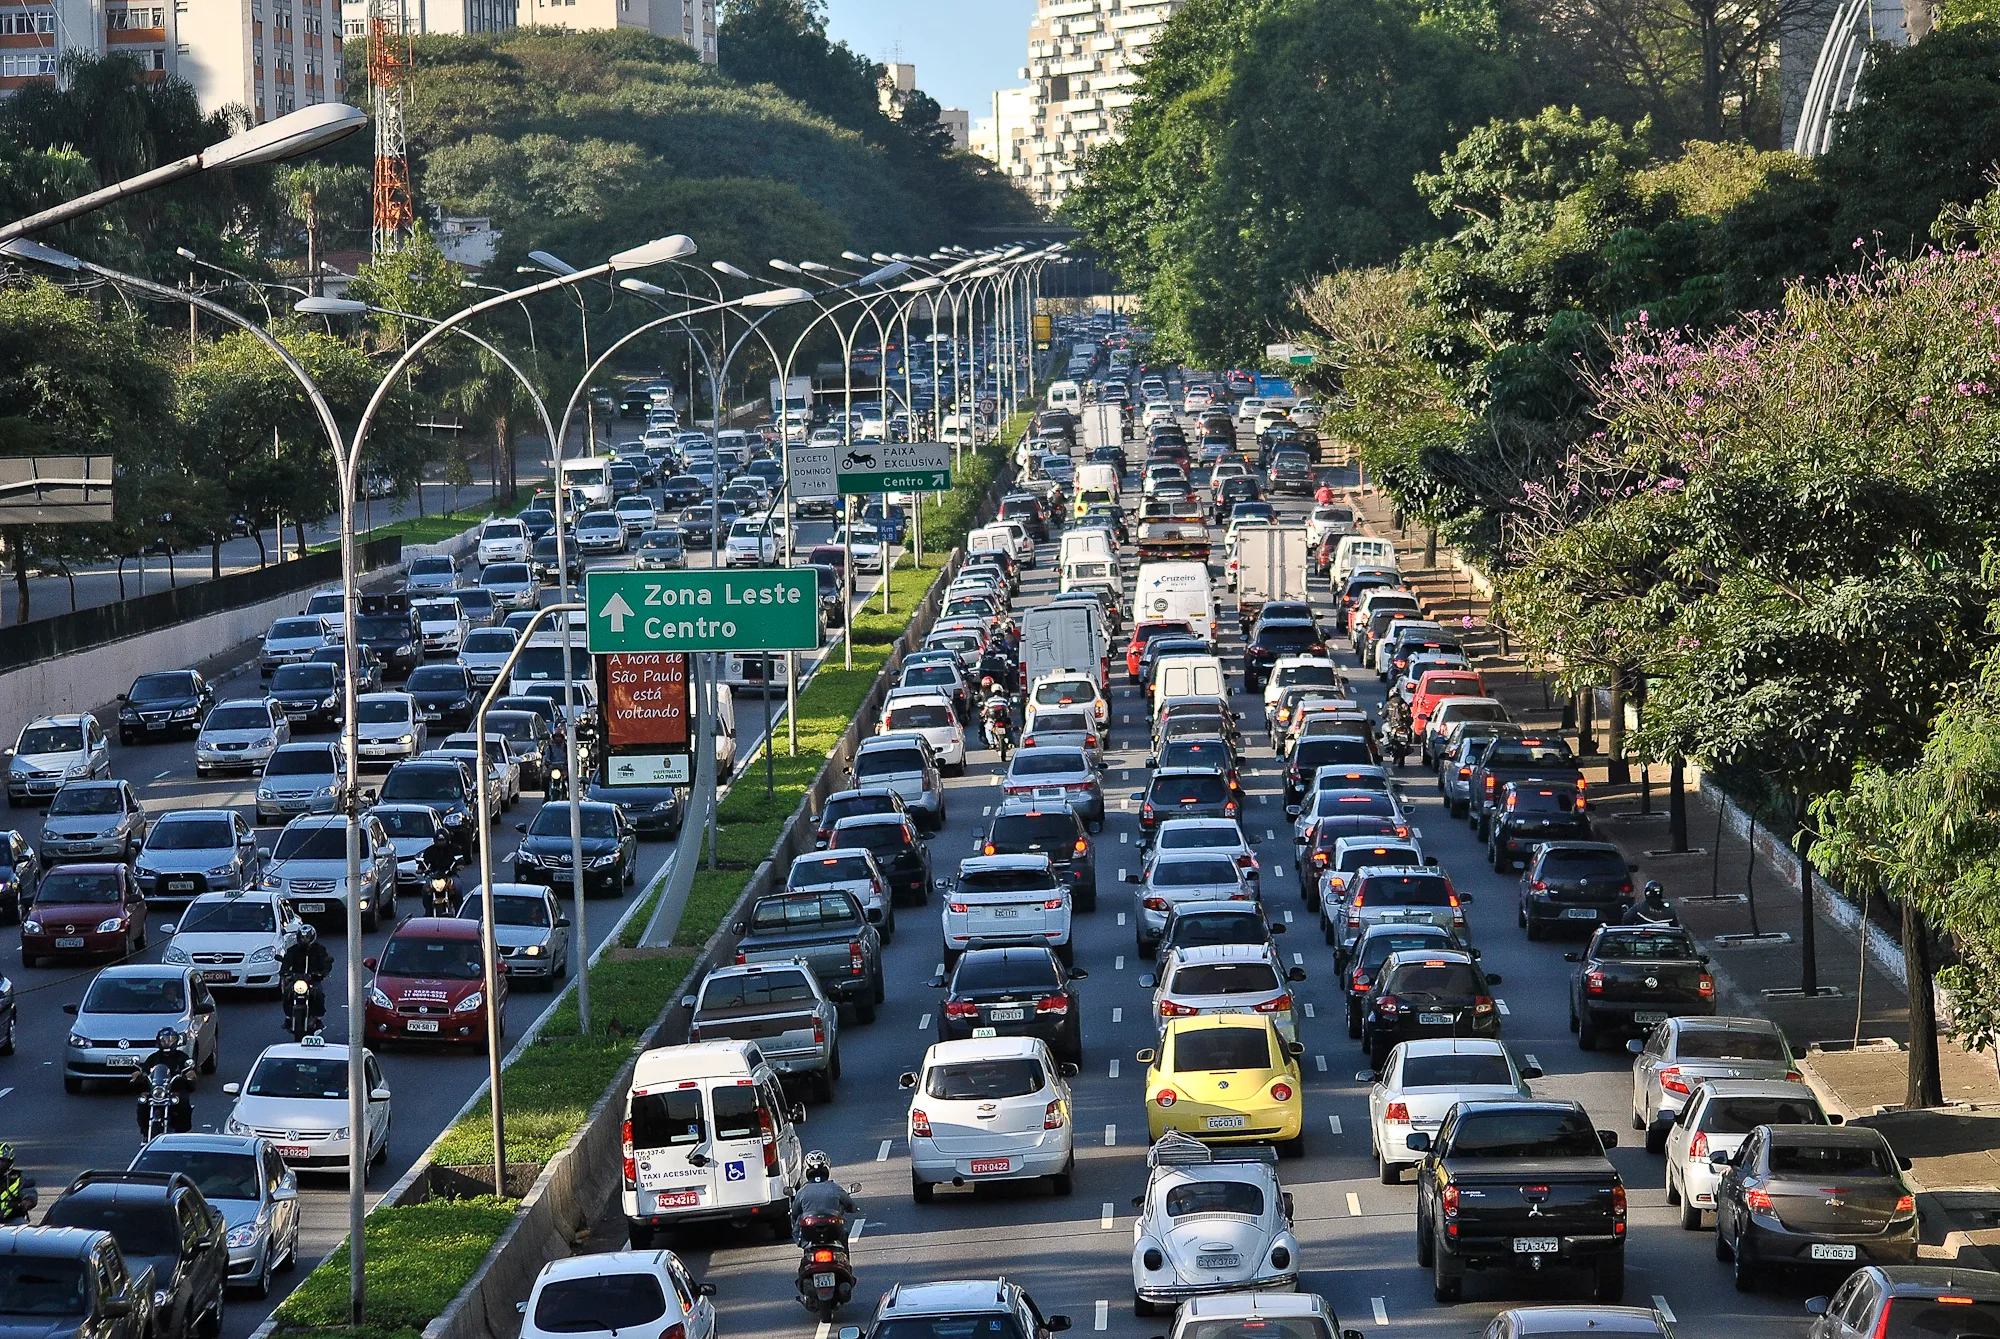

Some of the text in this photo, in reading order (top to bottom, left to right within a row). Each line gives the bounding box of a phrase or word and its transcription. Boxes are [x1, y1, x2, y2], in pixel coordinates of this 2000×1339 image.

[883, 447, 916, 456] FAIXA
[795, 455, 828, 464] EXCETO
[794, 467, 832, 477] DOMINGO
[883, 477, 924, 487] Centro
[1161, 574, 1197, 583] Cruzeiro
[644, 582, 802, 607] Zona Leste
[644, 615, 738, 641] Centro
[610, 653, 683, 666] A hora de
[611, 668, 683, 684] São Paulo
[632, 687, 662, 702] está
[616, 706, 680, 720] voltando
[976, 1029, 995, 1037] TAXI
[305, 1037, 321, 1045] TAXI
[642, 1173, 661, 1181] TAXI
[1517, 1242, 1557, 1252] ETA-3472
[1814, 1248, 1854, 1258] FJY-0673
